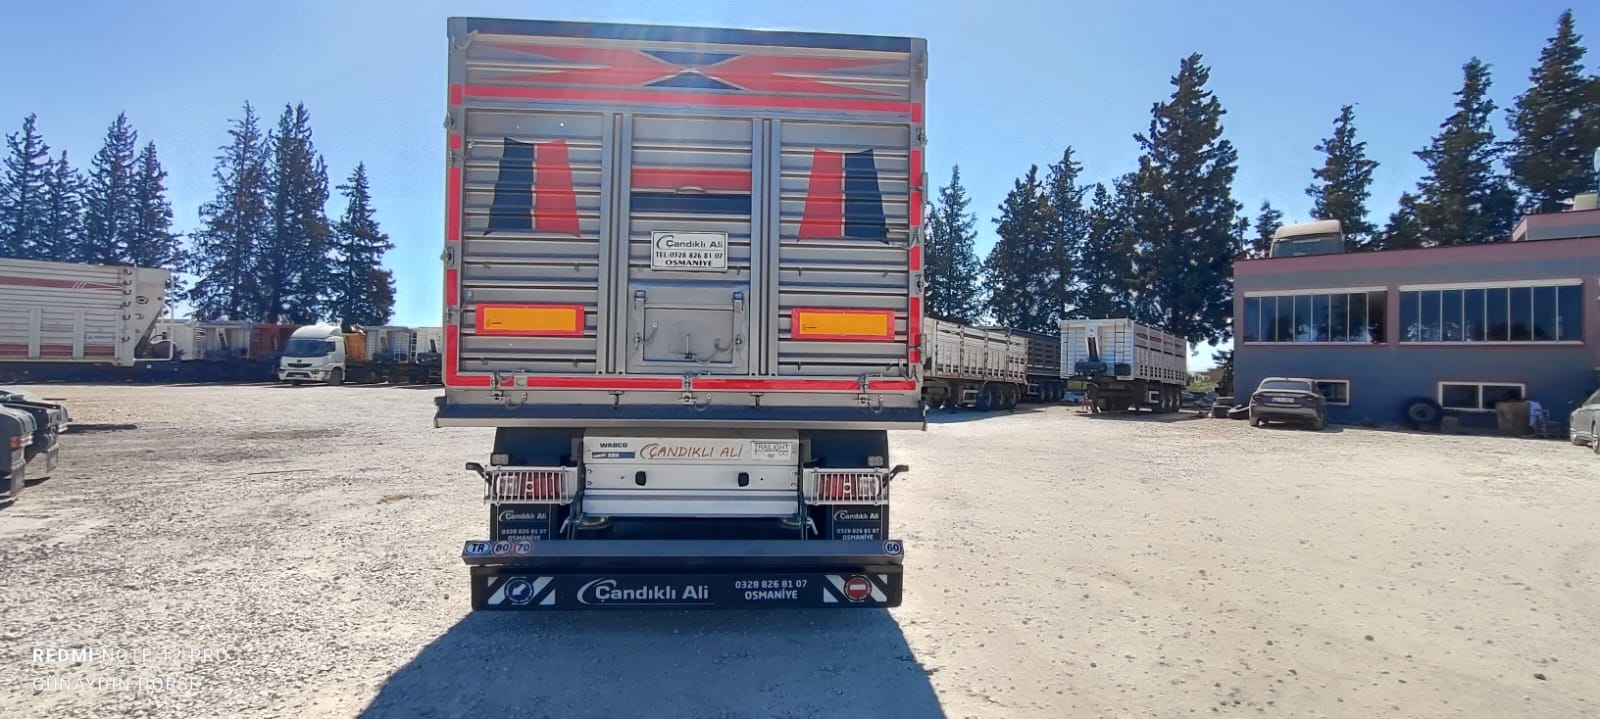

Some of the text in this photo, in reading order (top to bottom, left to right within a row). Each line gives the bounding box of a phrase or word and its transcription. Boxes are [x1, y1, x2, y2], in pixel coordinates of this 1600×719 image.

[709, 240, 723, 249] Ali
[472, 543, 486, 553] TR
[496, 543, 510, 552] 80
[517, 543, 530, 552] 70
[887, 543, 900, 552] 60
[735, 579, 808, 589] 0328 826 81 07
[594, 584, 709, 603] Çandıklı Ali
[744, 588, 798, 600] OSMANİYE
